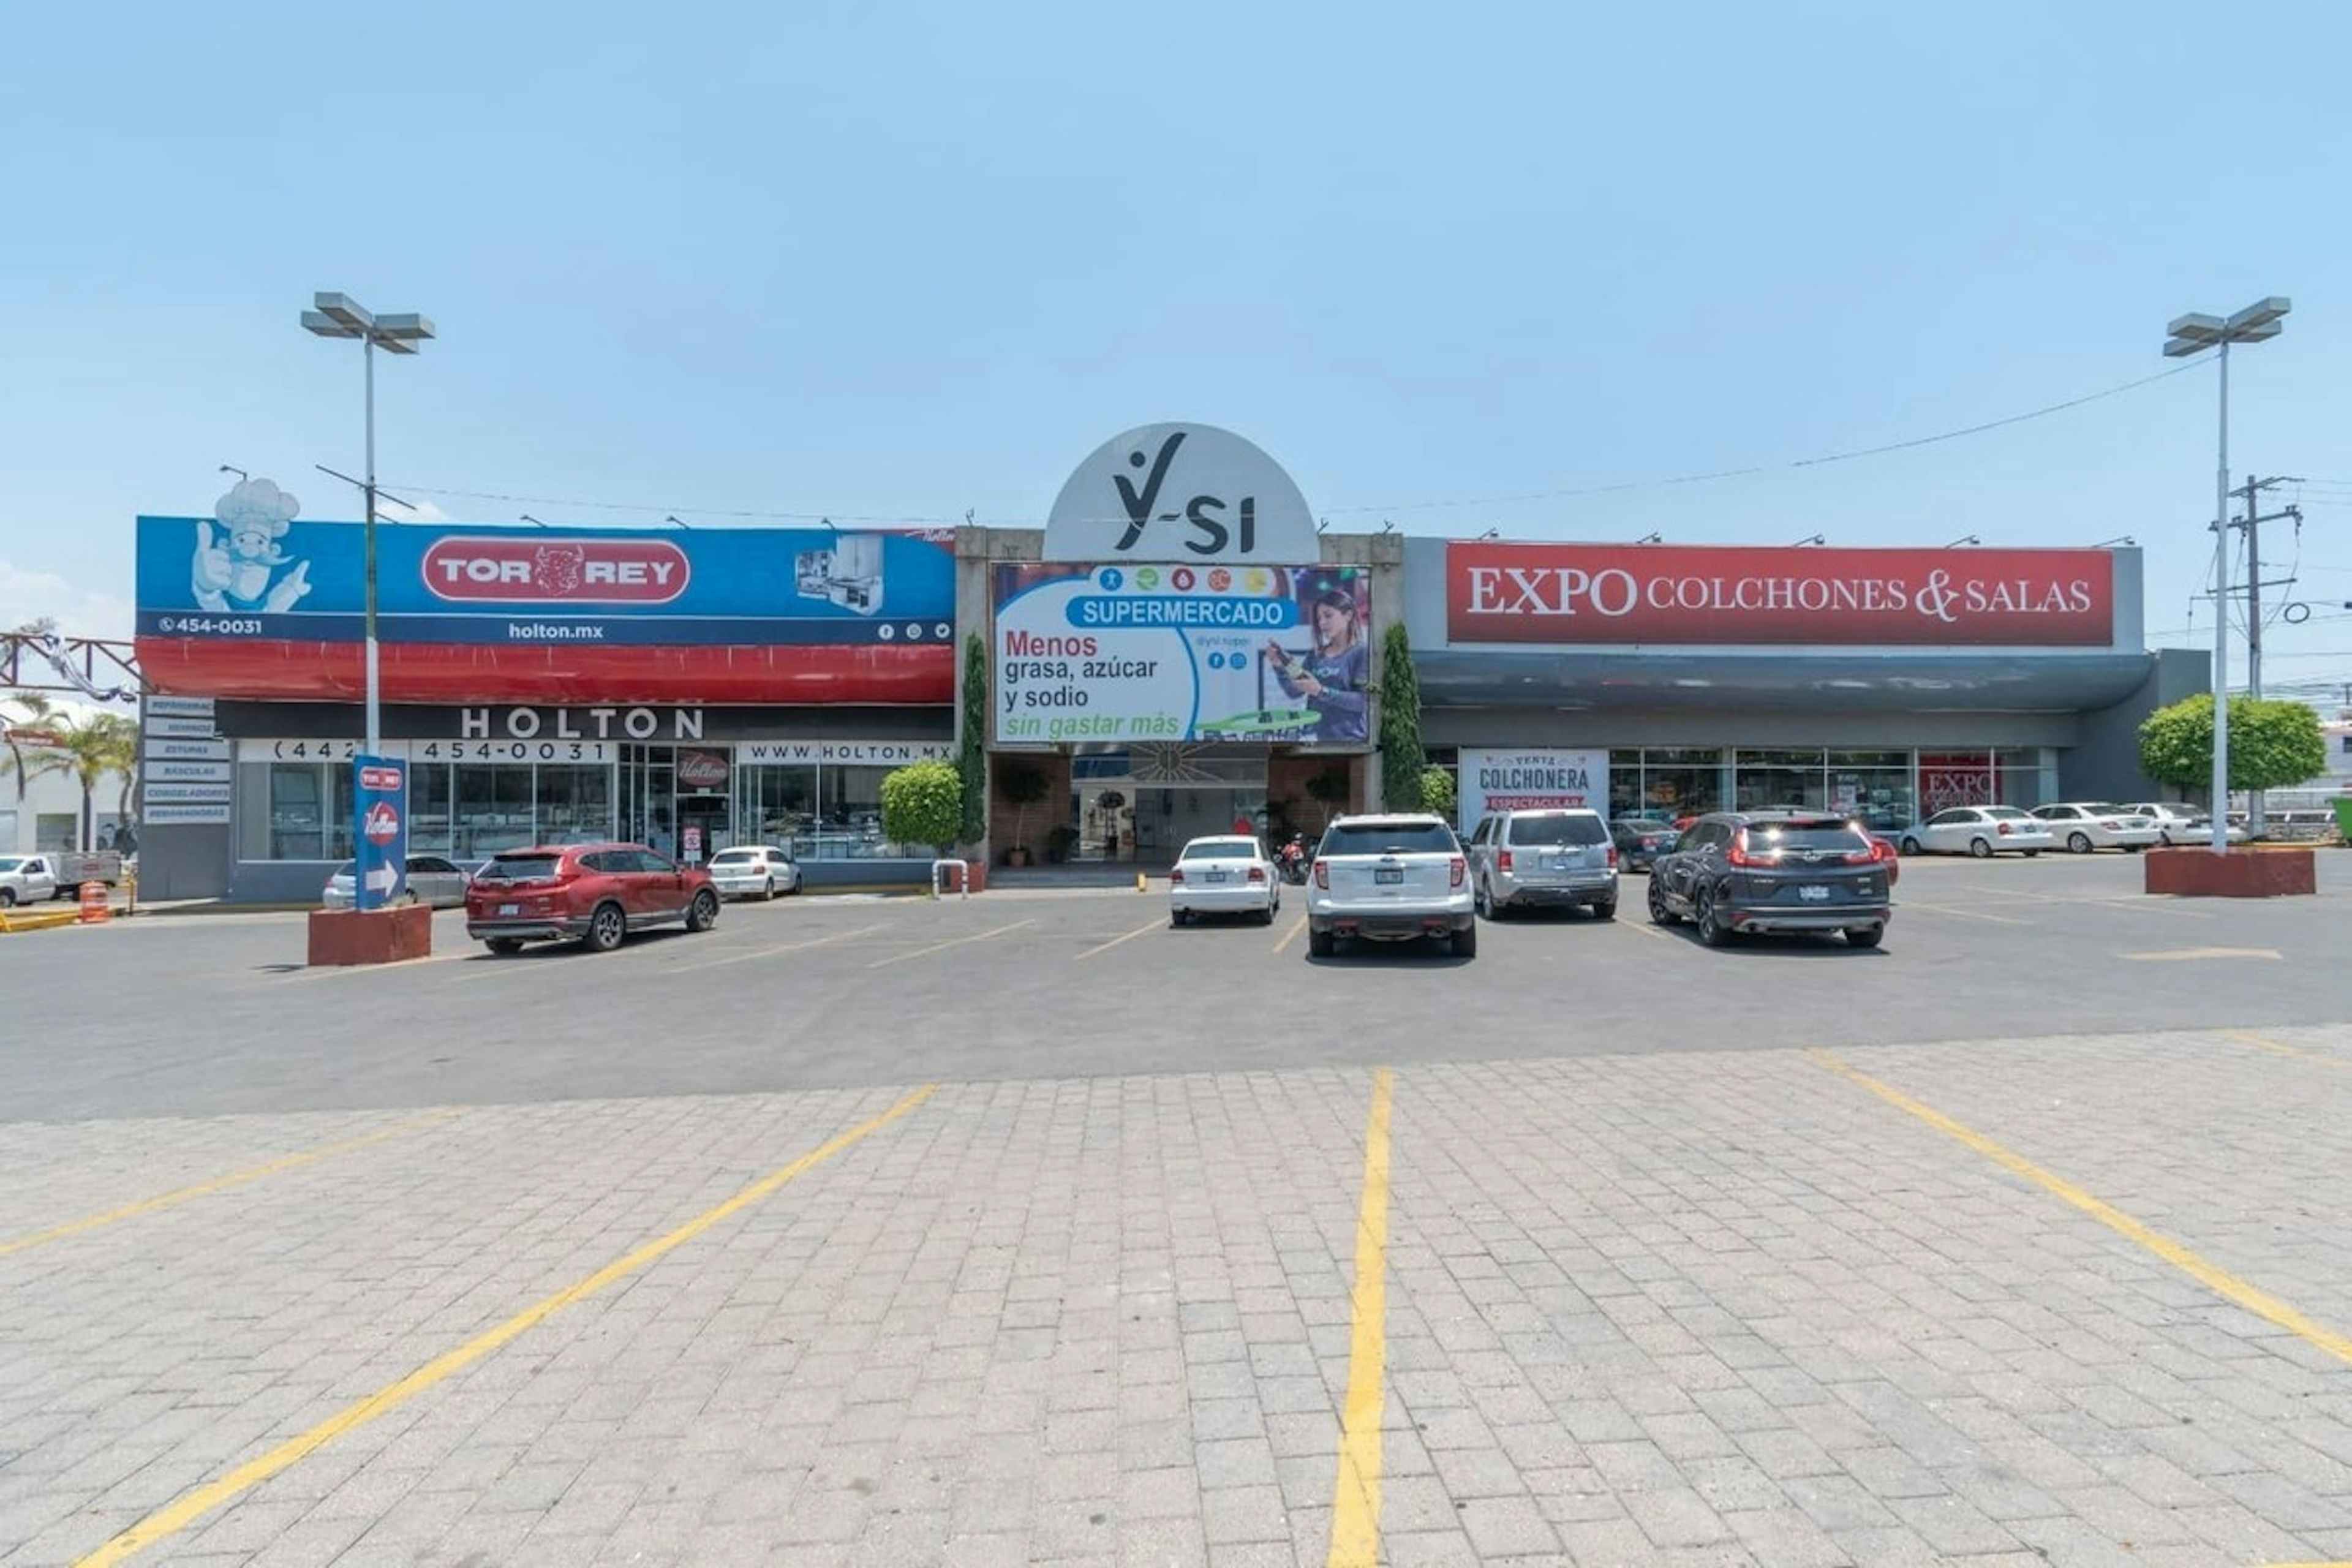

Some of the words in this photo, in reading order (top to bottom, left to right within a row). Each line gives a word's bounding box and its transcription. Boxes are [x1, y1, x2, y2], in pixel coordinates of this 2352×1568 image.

[438, 559, 532, 583] TOR
[584, 562, 674, 584] REY
[1466, 567, 1638, 616] EXPO
[1646, 577, 1907, 611] COLCHONES
[1915, 568, 1959, 622] &
[1966, 579, 2091, 611] SALAS
[1083, 601, 1284, 625] SUPERMERCADO
[177, 619, 262, 635] 454-0031
[508, 622, 603, 639] holton.mx
[1006, 631, 1097, 655] Menos
[1006, 659, 1075, 683] grasa,
[1083, 655, 1157, 677] azúcar
[1006, 689, 1017, 712] y
[1025, 683, 1088, 706] sodio
[461, 707, 704, 739] HOLTON
[1007, 712, 1042, 736] sin
[1049, 714, 1125, 741] gastar
[1130, 712, 1178, 734] más
[424, 742, 603, 760] 454-0031
[752, 746, 951, 760] WWW.HOLTON.MX
[1516, 756, 1556, 764] VENTA
[1480, 769, 1589, 790] COLCHONERA
[1490, 797, 1580, 807] ESPECTACULAR
